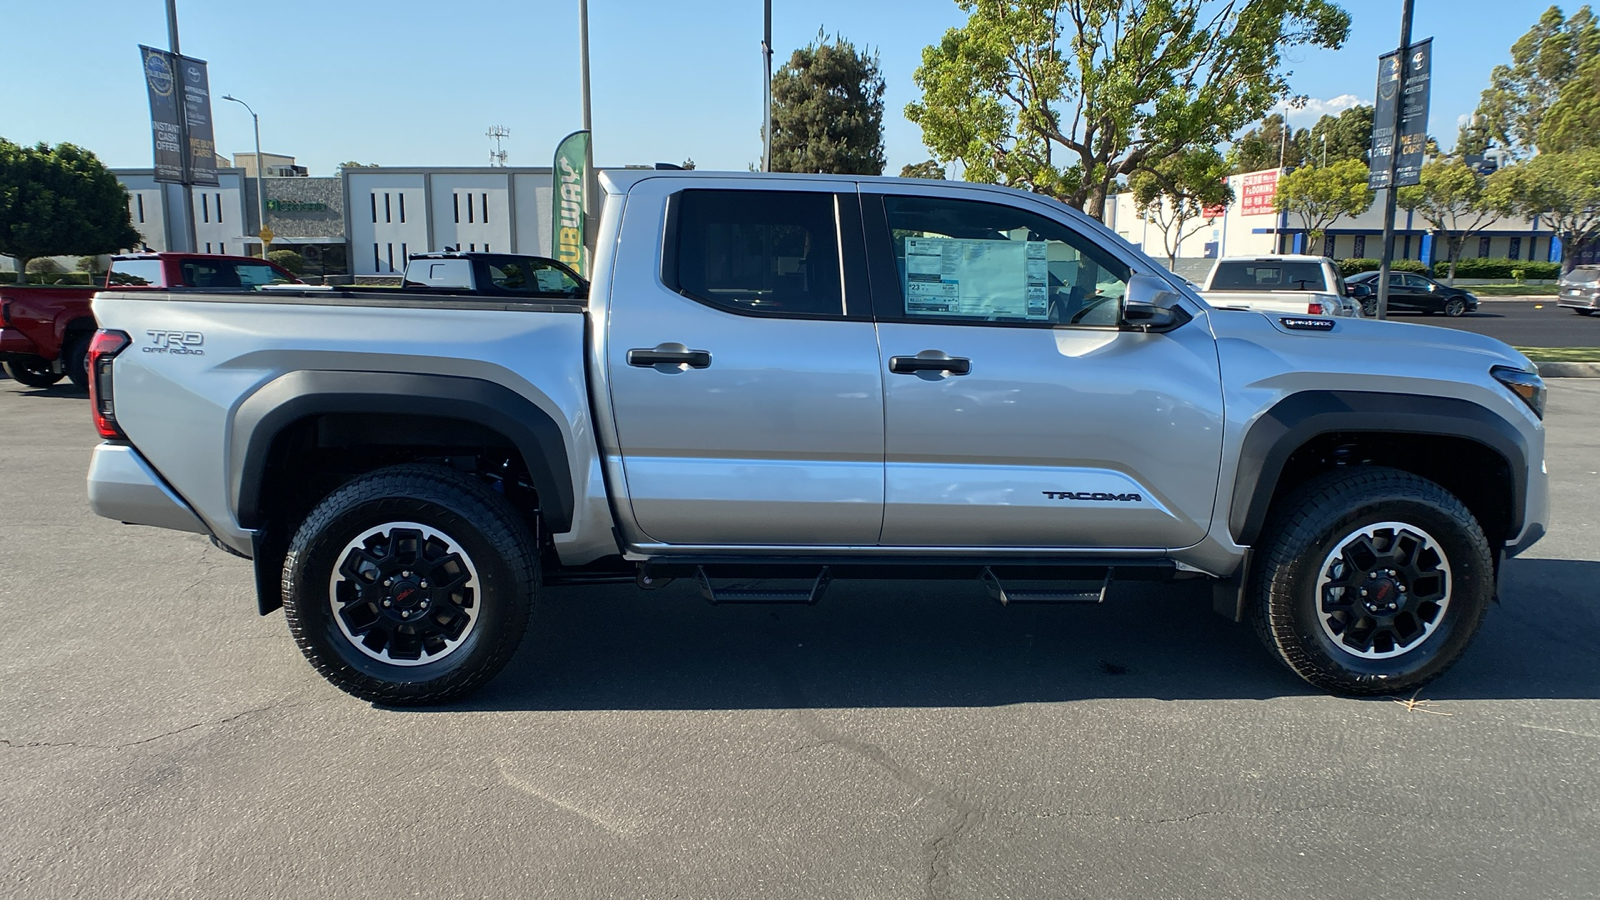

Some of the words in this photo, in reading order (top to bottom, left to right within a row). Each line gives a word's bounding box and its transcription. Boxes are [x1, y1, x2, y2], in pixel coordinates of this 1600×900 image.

[1405, 84, 1424, 95] CENTER
[185, 94, 203, 103] CENTER
[152, 121, 180, 134] INSTANT
[158, 131, 177, 142] CASH
[1401, 133, 1412, 145] WE
[189, 138, 200, 147] WE
[201, 139, 214, 150] BUY
[1246, 183, 1274, 195] FLOORING
[147, 329, 204, 349] TRD
[142, 346, 168, 354] OFF
[170, 348, 205, 356] ROAD
[1042, 491, 1142, 502] TACOMA
